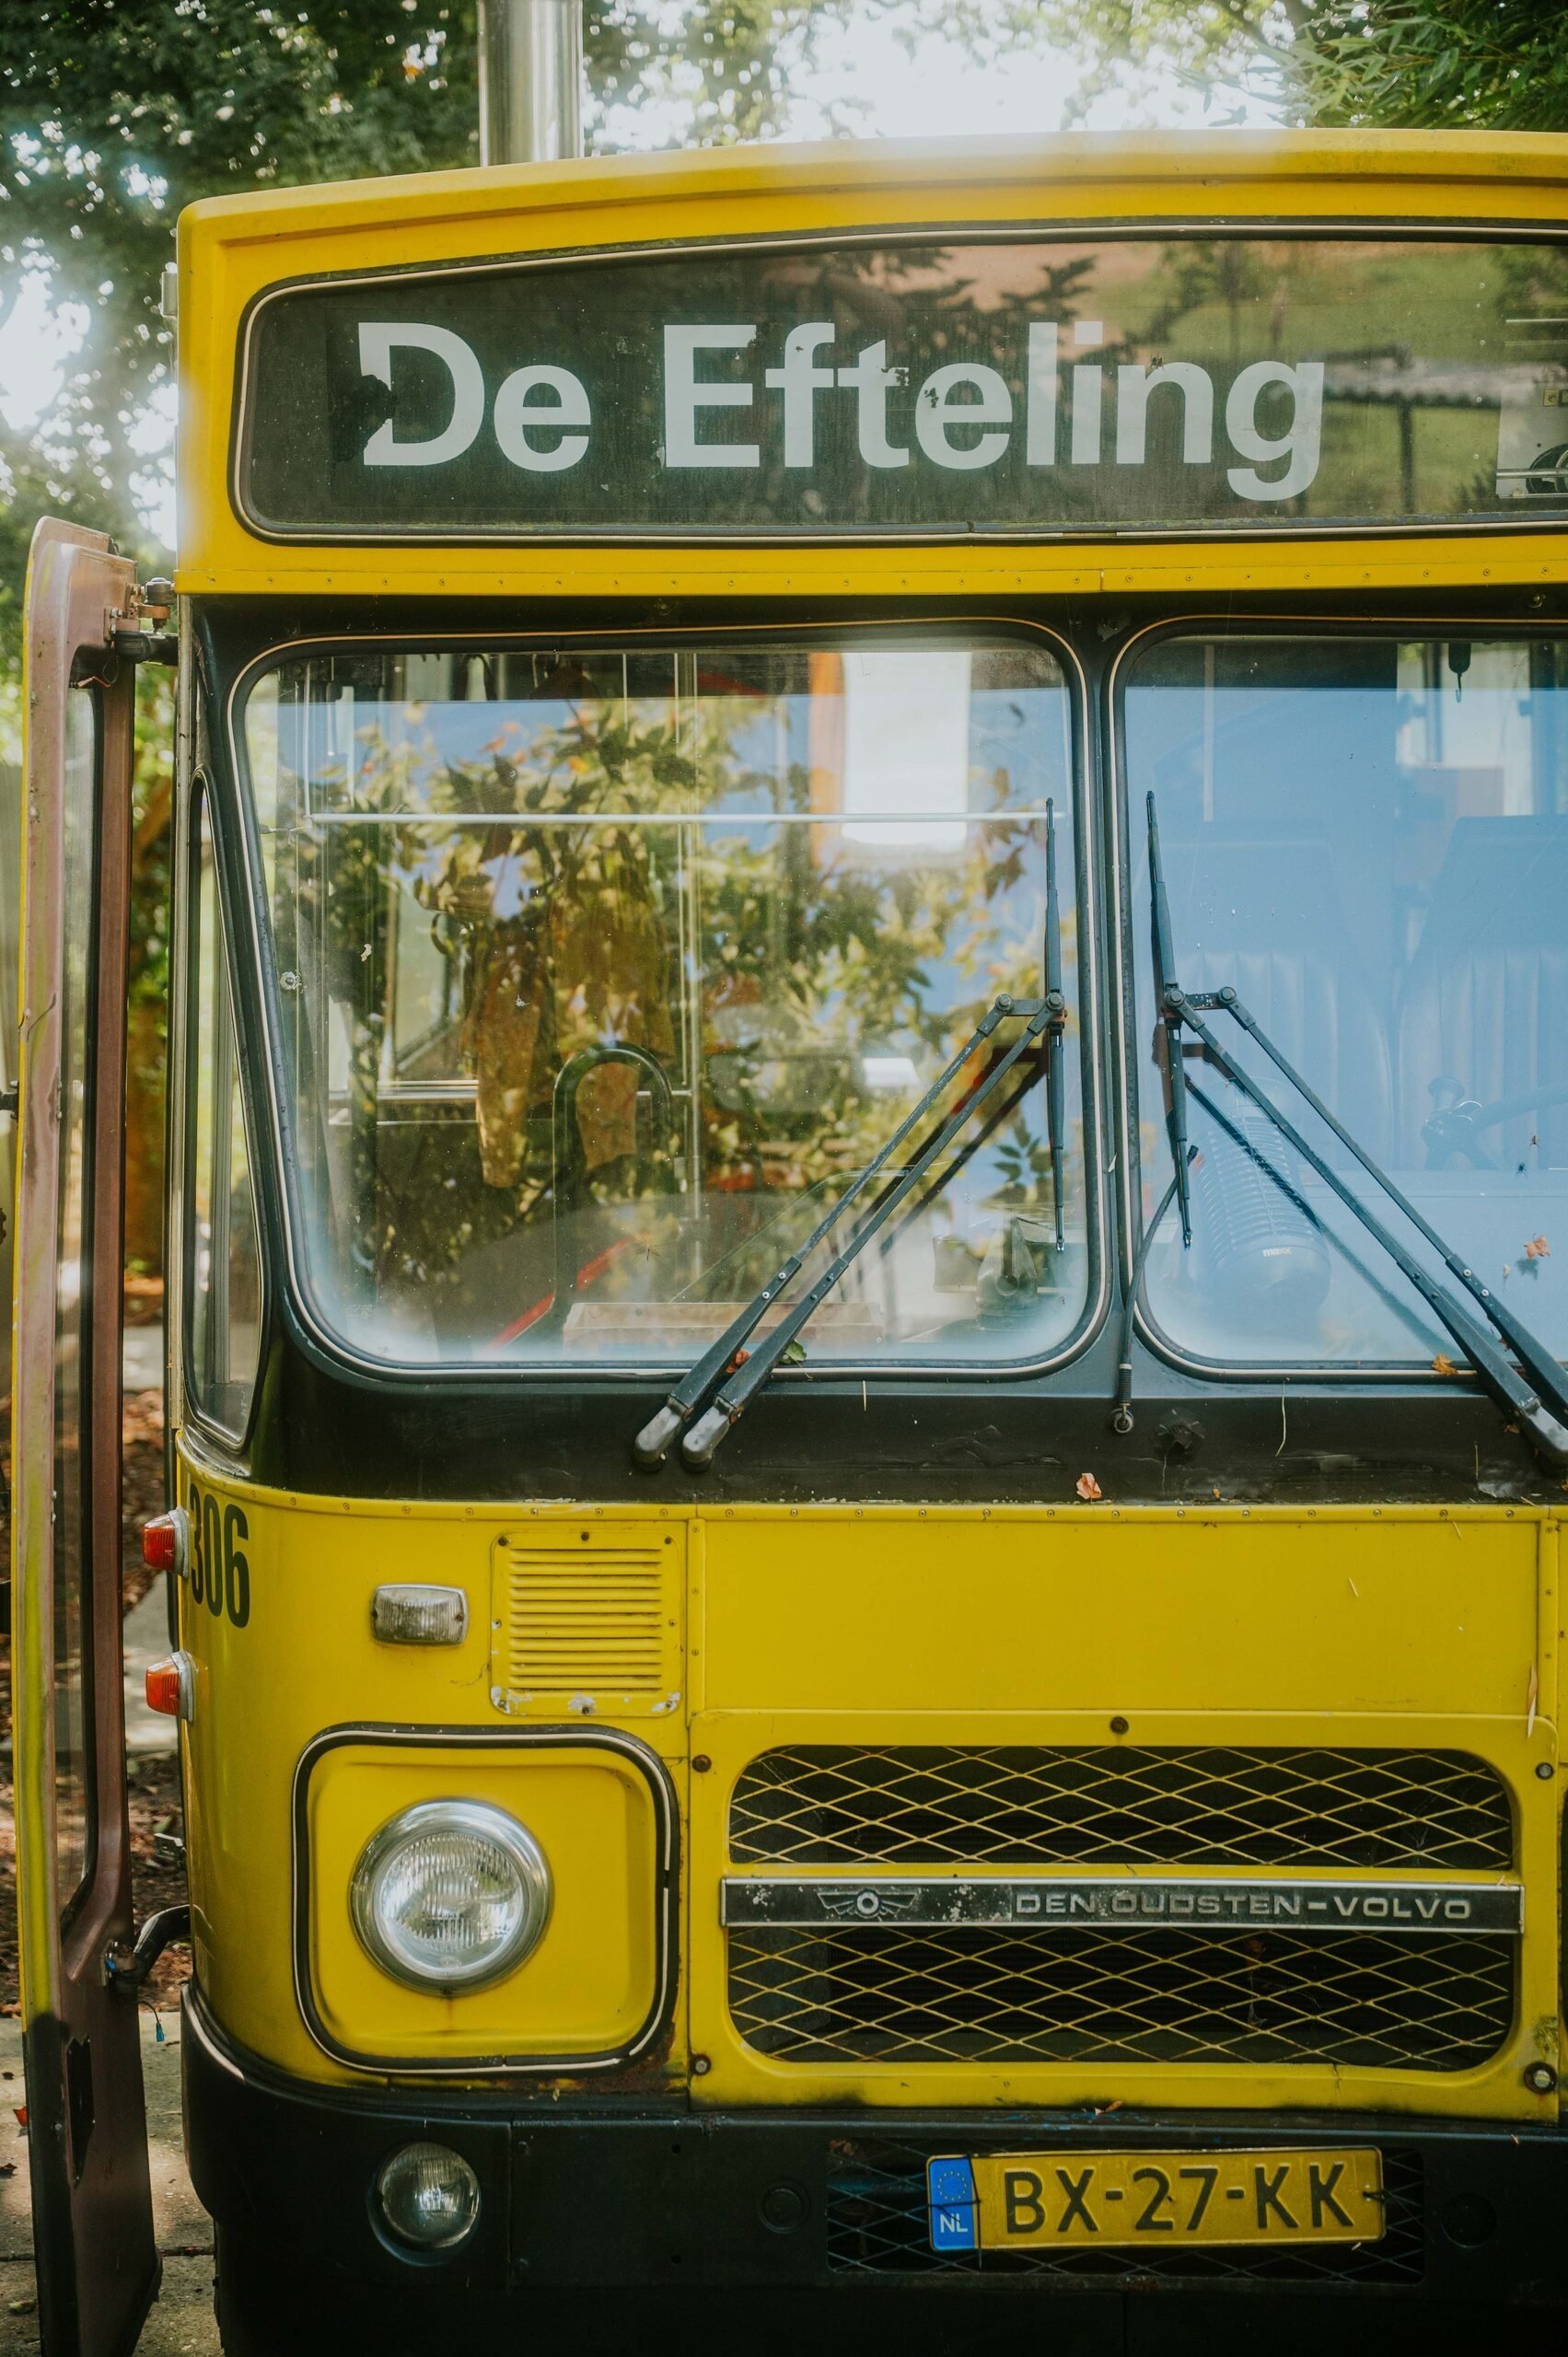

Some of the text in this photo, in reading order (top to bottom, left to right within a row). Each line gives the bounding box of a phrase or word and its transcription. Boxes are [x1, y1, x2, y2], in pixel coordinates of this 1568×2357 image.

[358, 321, 1326, 501] De Efteling
[190, 1483, 250, 1629] 306
[1016, 1893, 1096, 1914] DEN
[940, 2212, 969, 2234] NL
[1004, 2163, 1354, 2234] BX-27-KK
